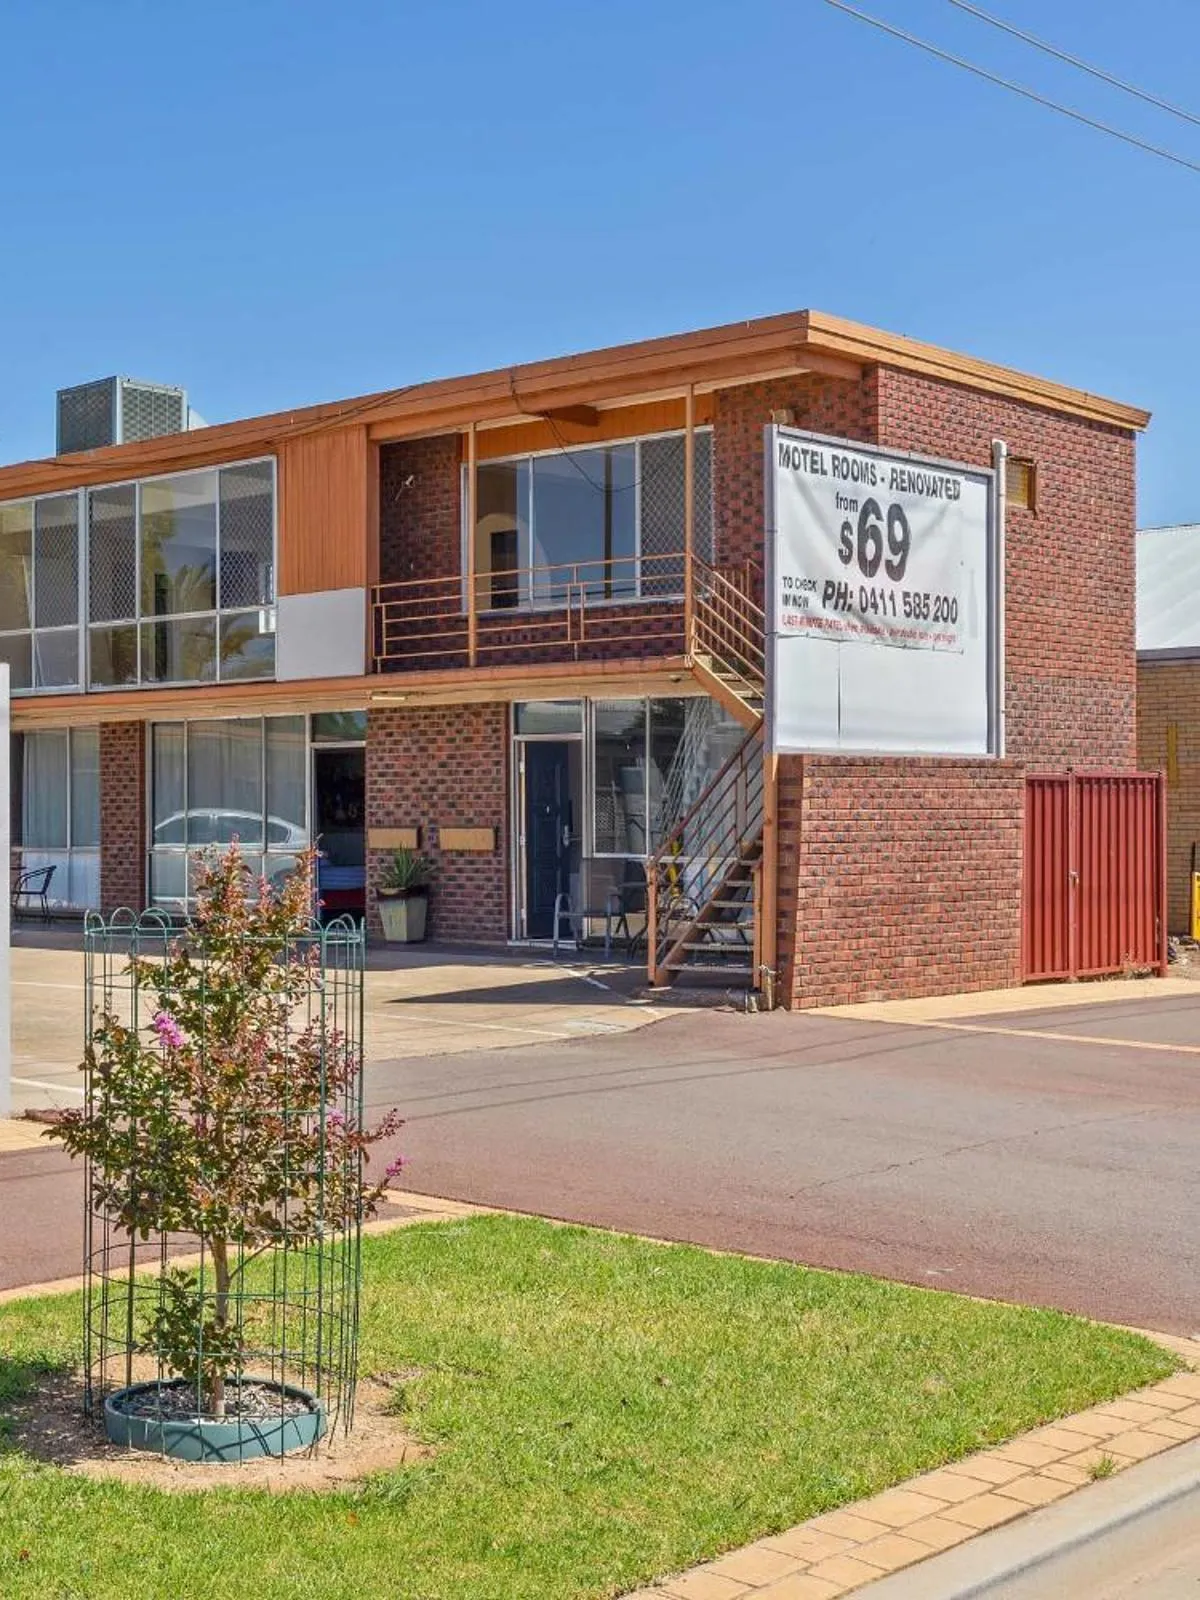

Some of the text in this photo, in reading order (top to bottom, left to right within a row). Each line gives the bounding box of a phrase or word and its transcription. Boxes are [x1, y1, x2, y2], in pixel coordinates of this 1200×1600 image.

[778, 443, 828, 476] MOTEL
[831, 454, 877, 487] ROOMS
[889, 467, 961, 500] RENOVATED
[835, 491, 858, 512] from
[838, 496, 910, 582] $69
[782, 576, 817, 592] TO CHECK
[822, 580, 958, 624] PH: 0411 585 200
